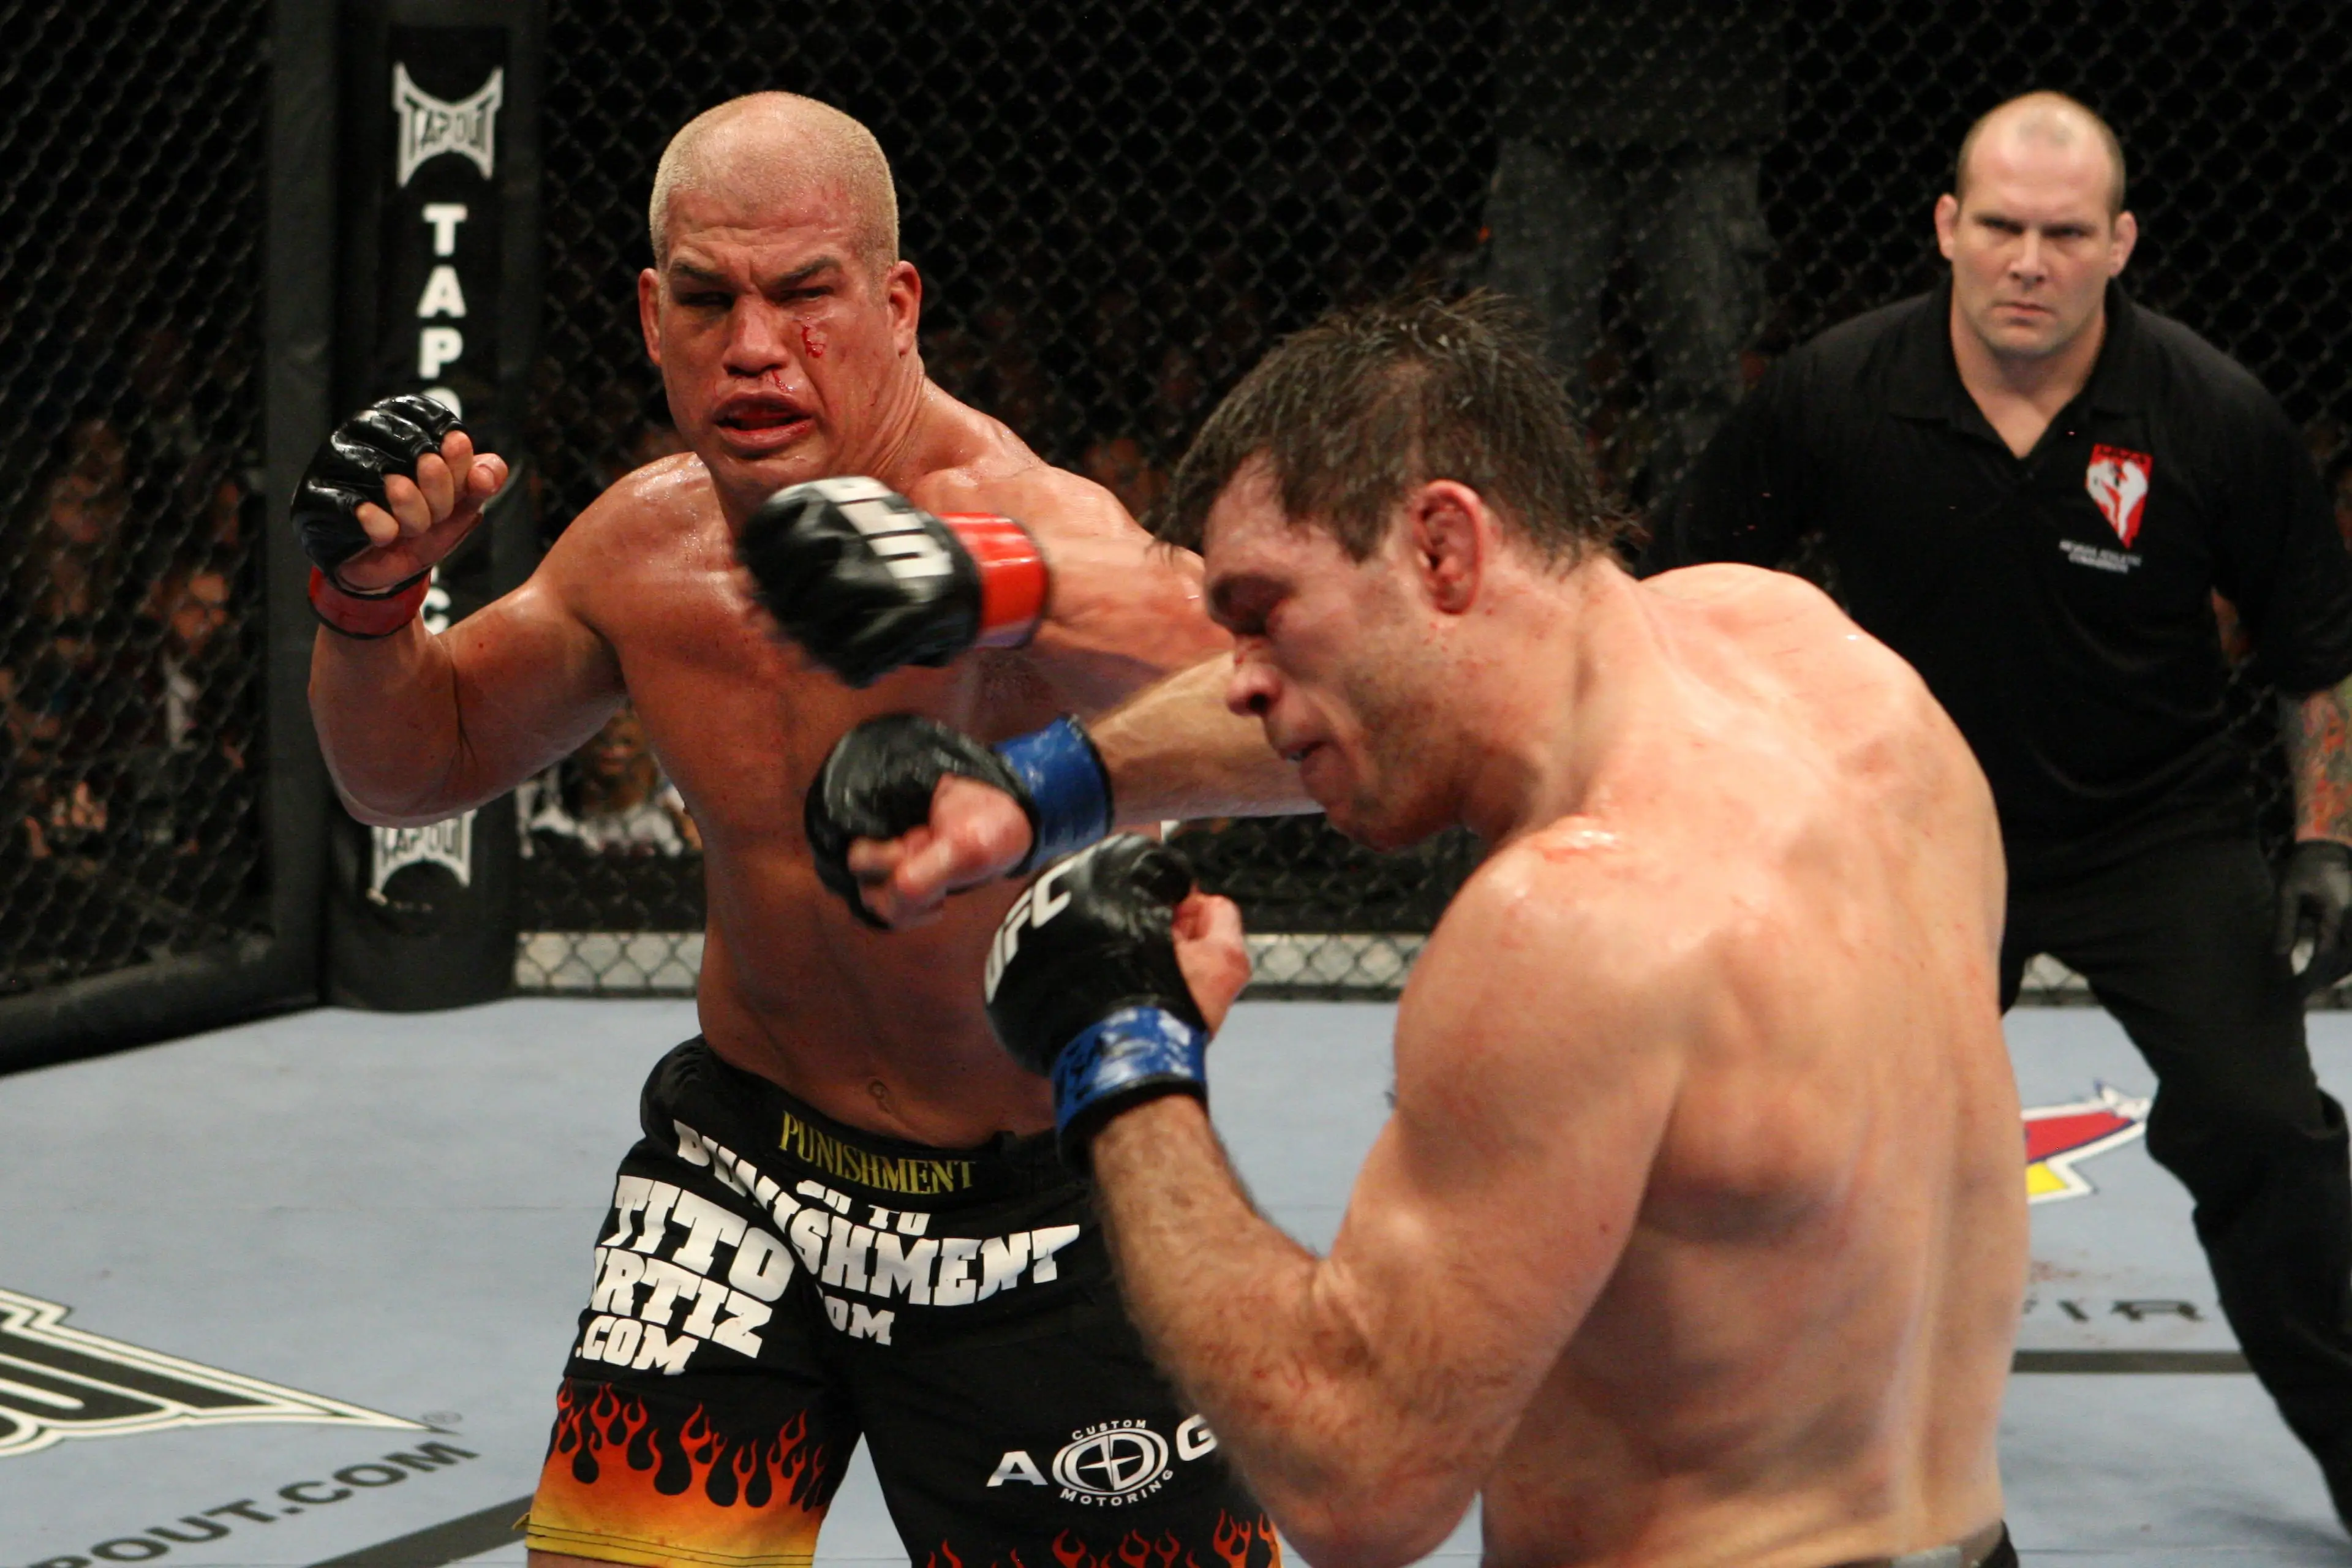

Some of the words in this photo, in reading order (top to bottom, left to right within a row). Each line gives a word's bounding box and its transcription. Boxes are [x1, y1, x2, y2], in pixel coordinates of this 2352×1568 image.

[984, 859, 1074, 1005] UFC
[778, 1110, 976, 1195] PUNISHMENT
[601, 1174, 795, 1302] TITO
[575, 1315, 699, 1376] .COM
[816, 1284, 895, 1346] OM
[1071, 1419, 1147, 1441] CUSTOM
[1059, 1468, 1174, 1507] MOTORING
